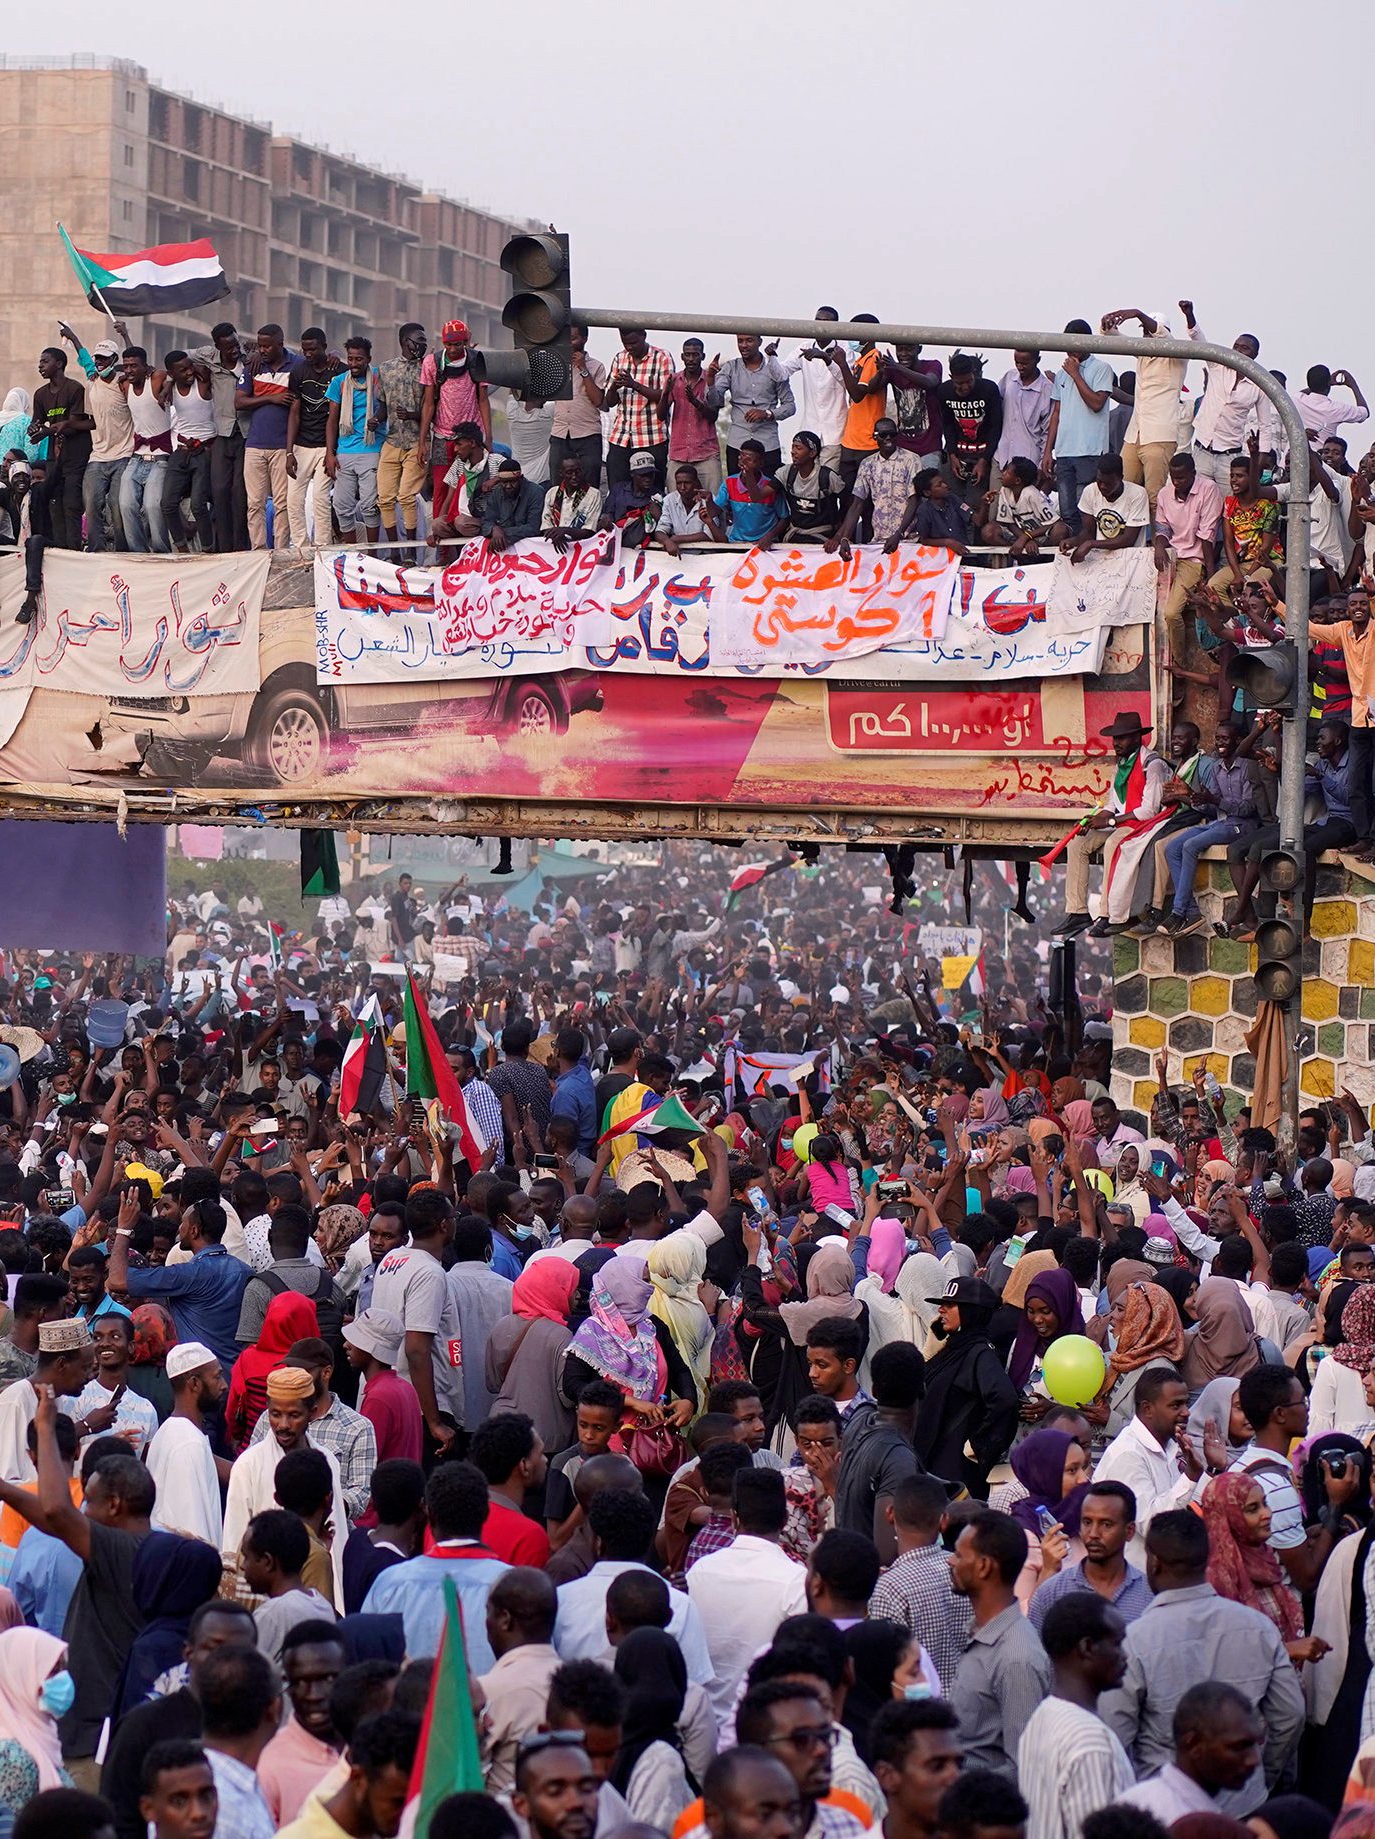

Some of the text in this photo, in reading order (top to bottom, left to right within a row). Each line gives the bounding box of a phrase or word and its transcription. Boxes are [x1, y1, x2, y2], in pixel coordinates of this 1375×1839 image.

[945, 399, 986, 410] CHICAGO
[538, 531, 617, 586] ثوار
[120, 580, 246, 691] ثوار
[849, 702, 912, 745] كم
[380, 1255, 410, 1276] Sup
